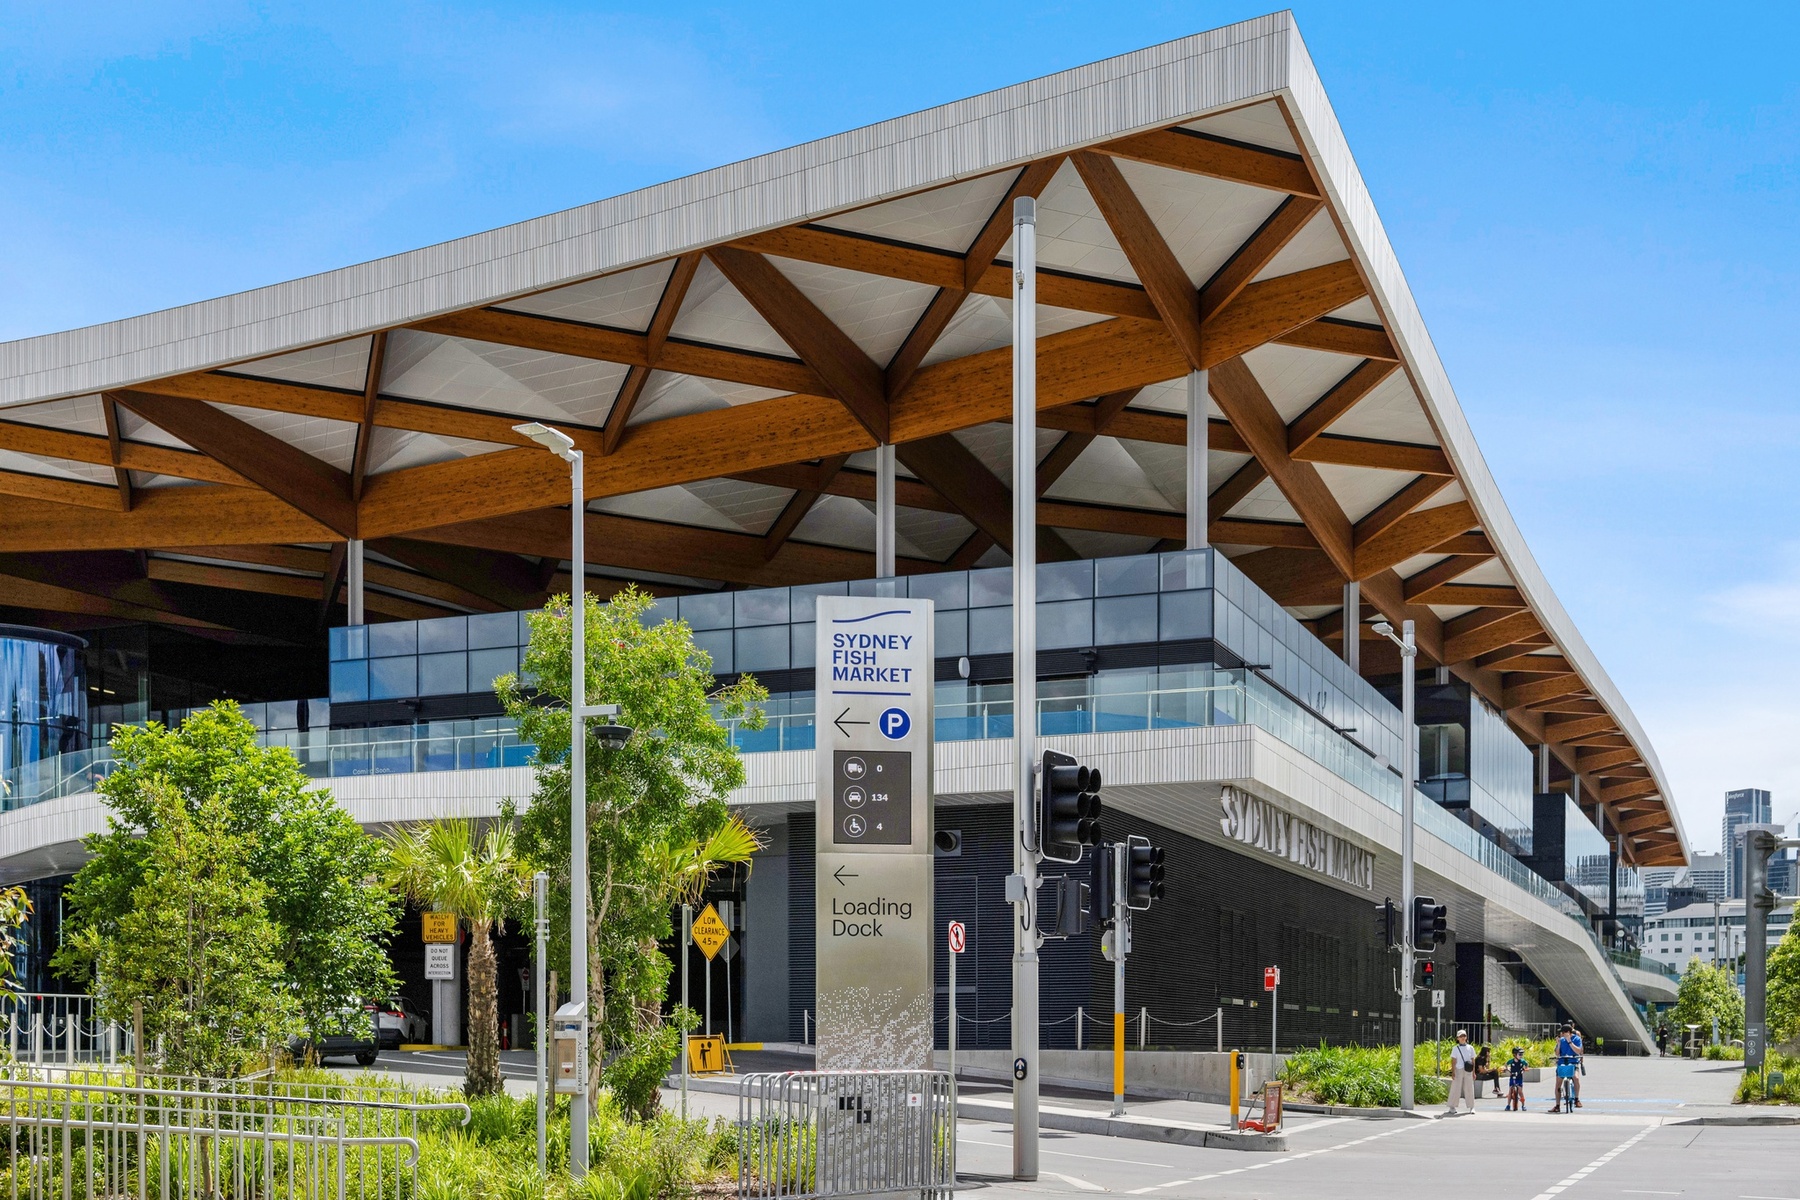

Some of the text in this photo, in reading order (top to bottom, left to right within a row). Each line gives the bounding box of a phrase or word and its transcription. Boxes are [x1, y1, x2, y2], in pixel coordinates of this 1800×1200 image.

[833, 634, 913, 651] SYDNEY
[833, 651, 877, 666] FISH
[833, 667, 912, 683] MARKET
[888, 714, 903, 734] P
[876, 765, 883, 773] 0
[871, 793, 889, 802] 134
[876, 823, 883, 831] 4
[832, 897, 912, 920] Loading
[694, 926, 725, 936] CLEARANCE
[833, 919, 883, 938] Dock
